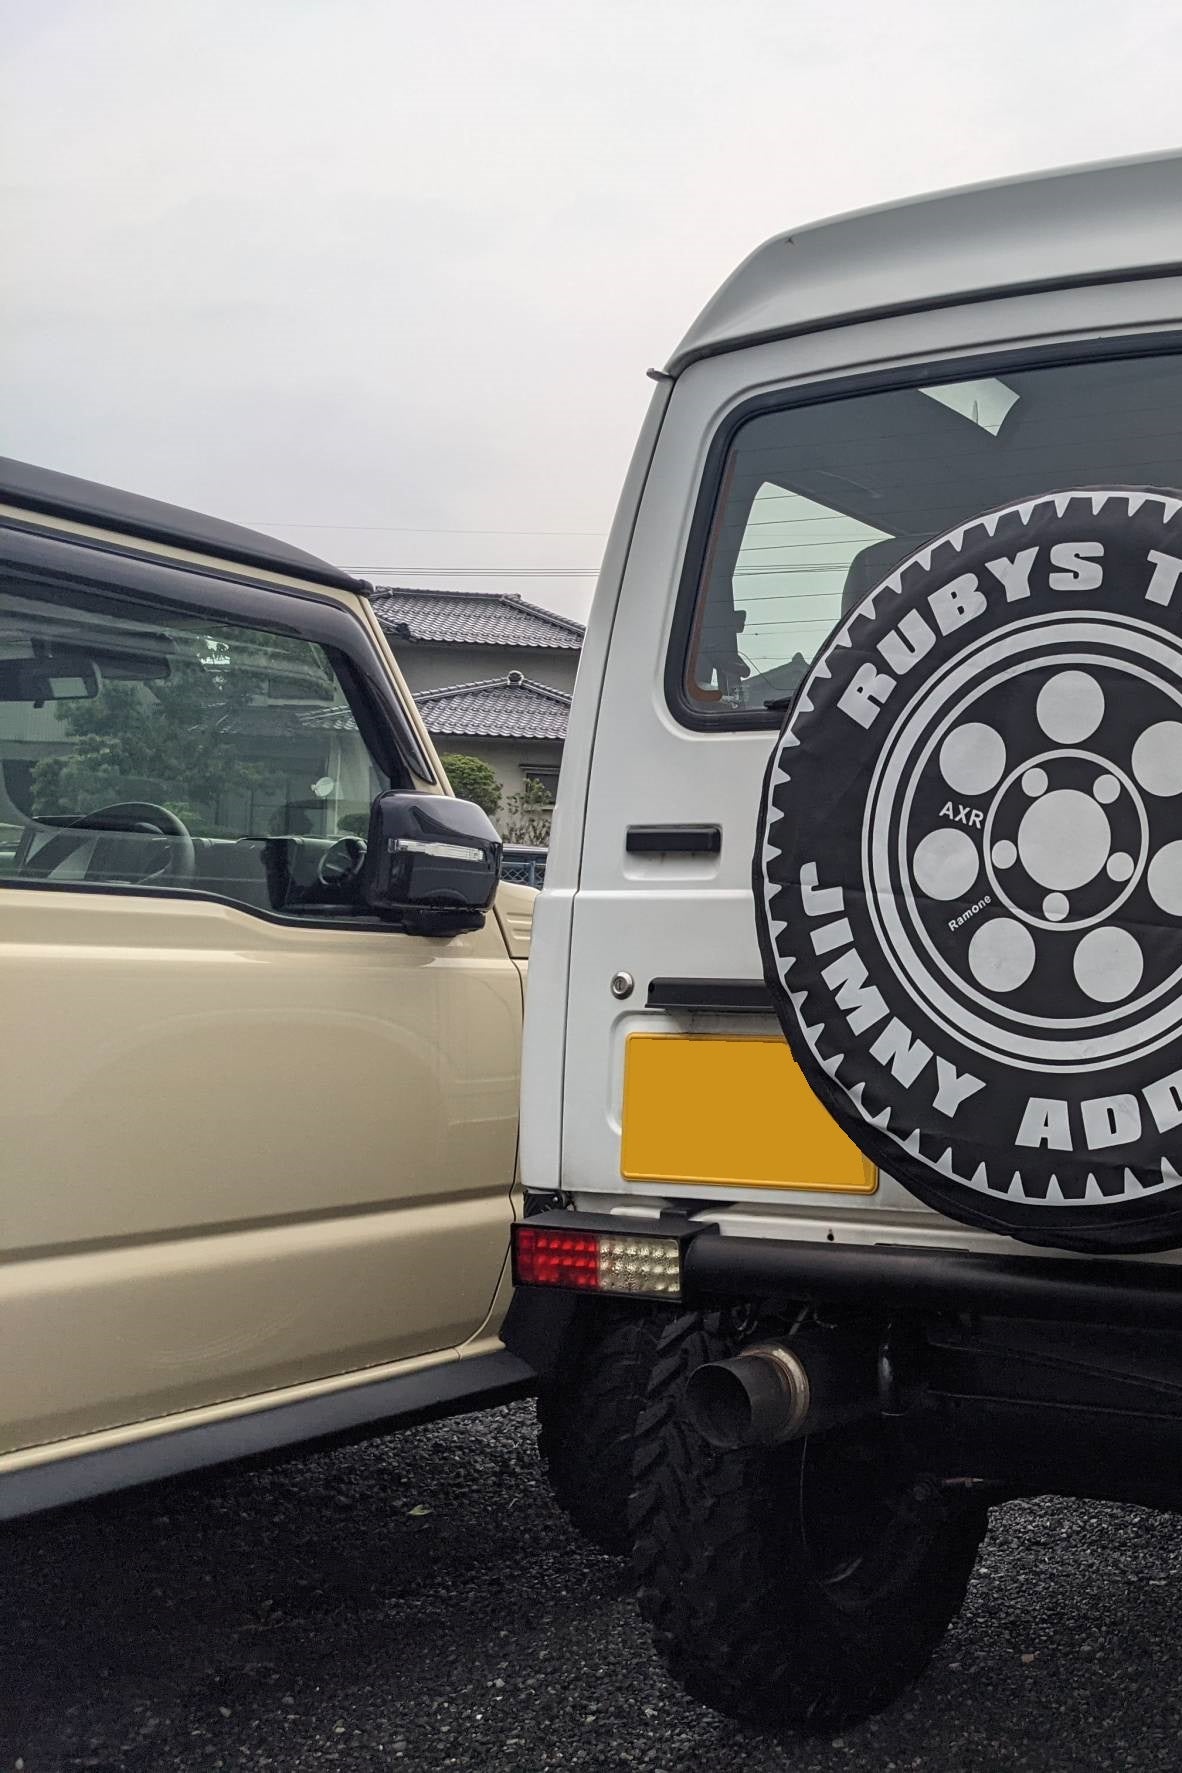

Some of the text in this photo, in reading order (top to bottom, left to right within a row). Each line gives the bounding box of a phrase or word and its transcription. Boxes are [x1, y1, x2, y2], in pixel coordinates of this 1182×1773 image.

[837, 542, 1104, 729] RUBYS
[939, 801, 983, 829] AXR
[948, 895, 991, 931] Ramone
[800, 862, 986, 1117] JIMNY
